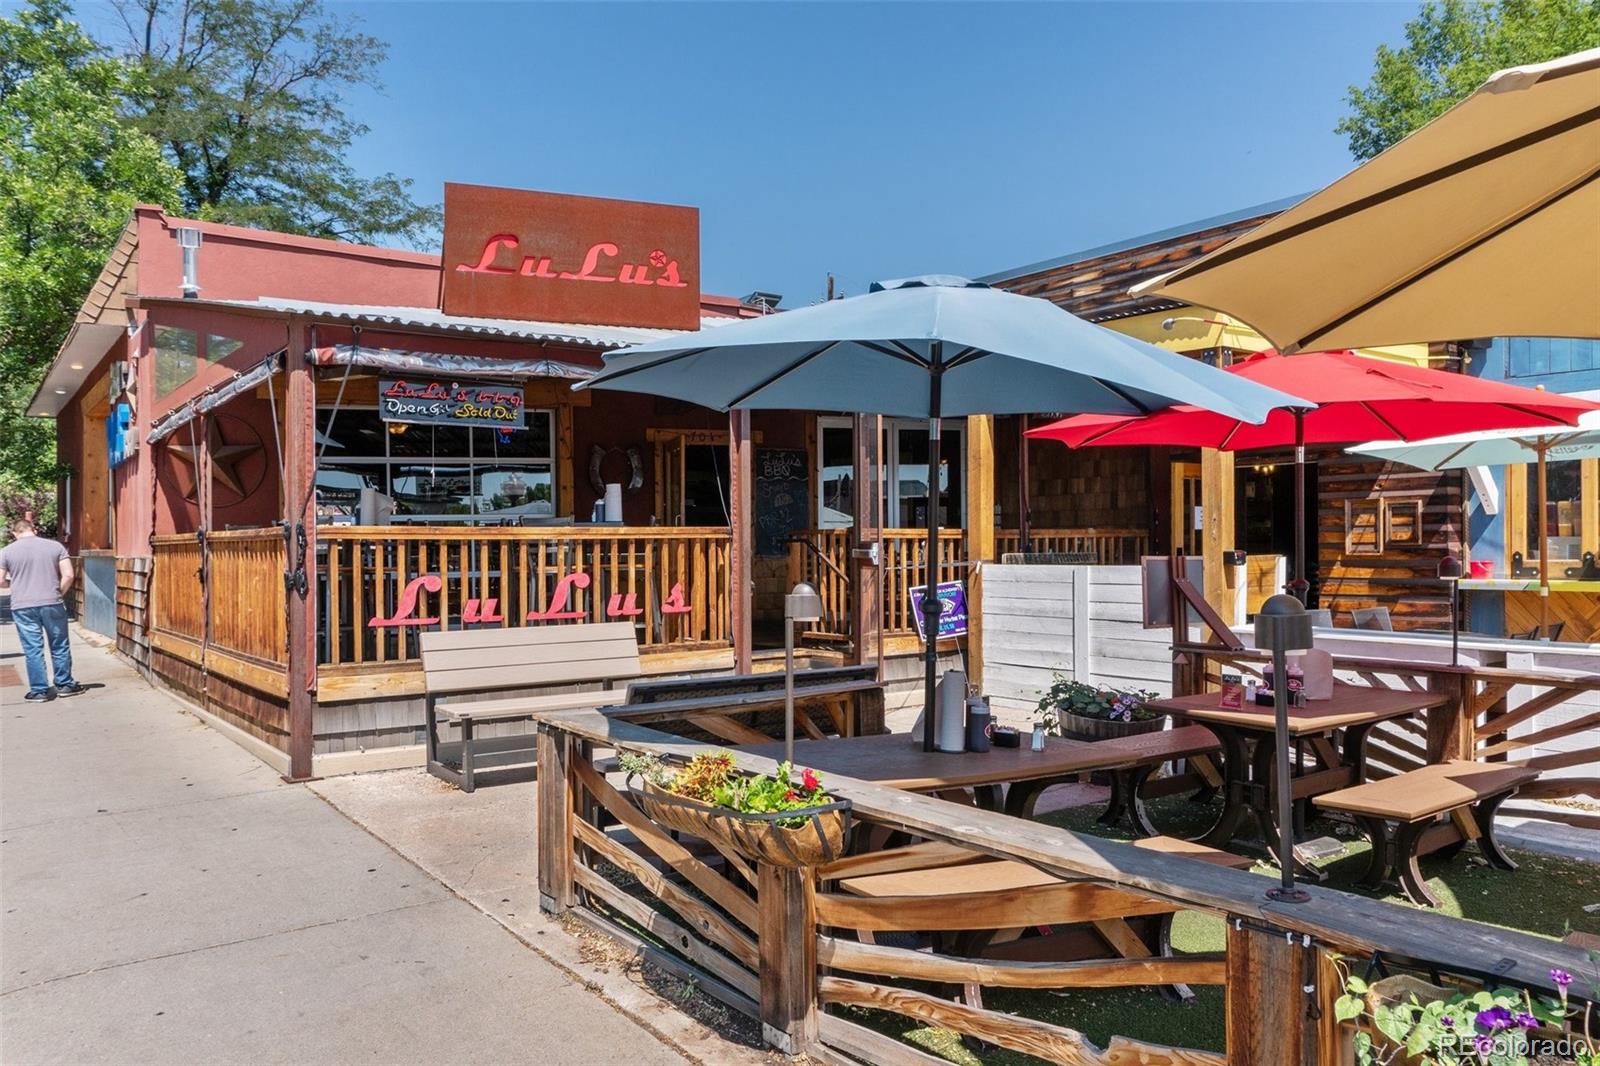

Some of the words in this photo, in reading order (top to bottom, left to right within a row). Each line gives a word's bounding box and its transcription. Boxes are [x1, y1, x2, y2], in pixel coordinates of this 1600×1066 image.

[385, 398, 427, 415] Open
[455, 403, 492, 418] Sold
[495, 405, 518, 420] Out
[764, 465, 791, 477] BBQ
